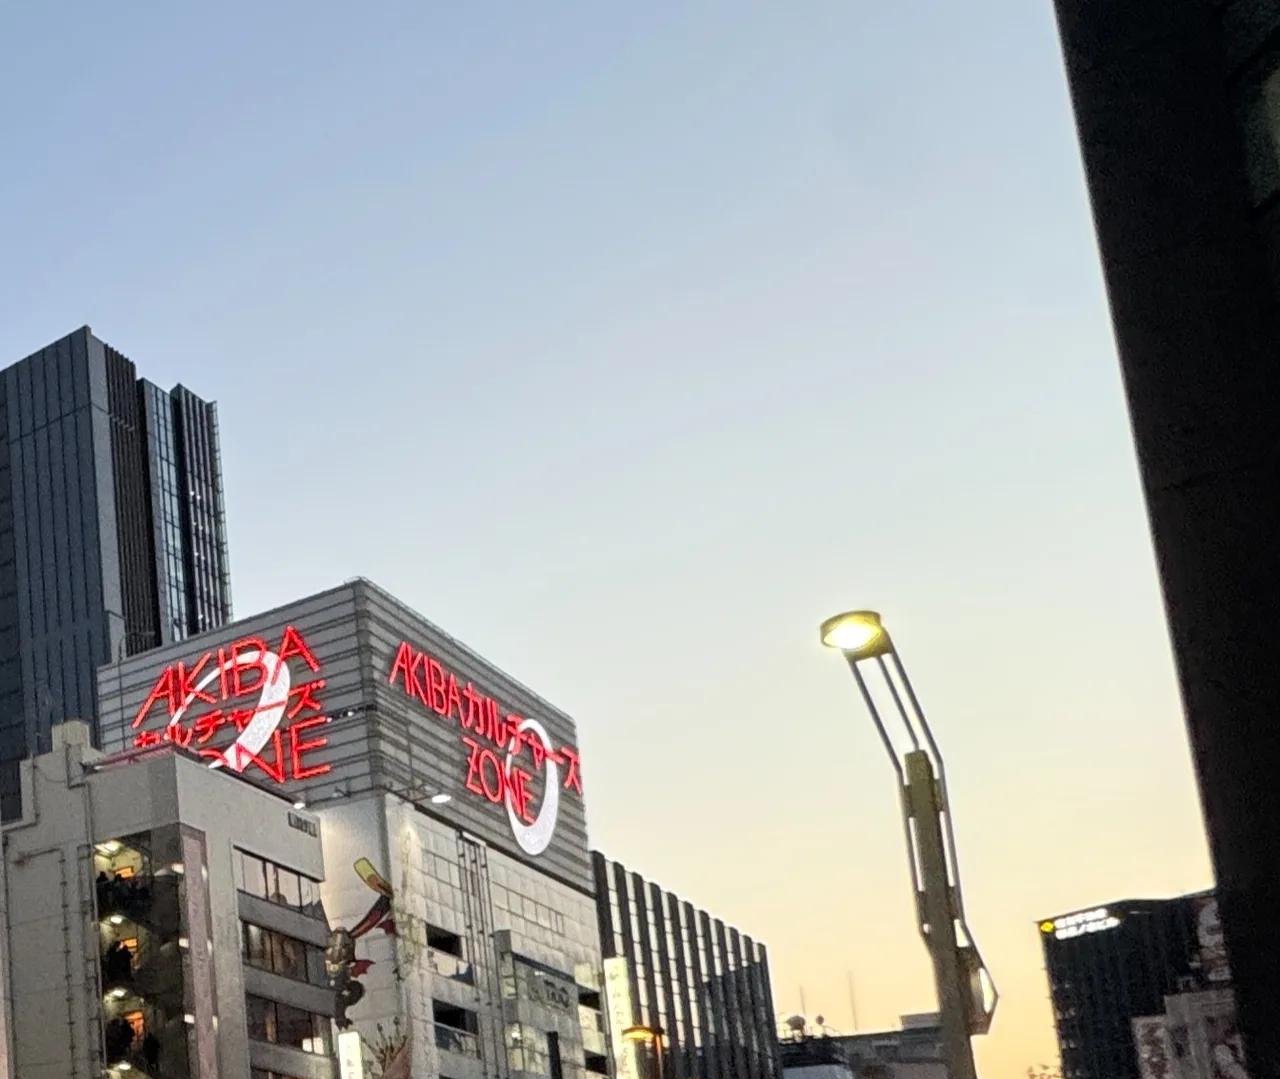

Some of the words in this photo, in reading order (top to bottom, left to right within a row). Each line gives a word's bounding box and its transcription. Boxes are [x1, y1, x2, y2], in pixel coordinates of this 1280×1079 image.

[132, 625, 320, 728] AKIBA
[389, 641, 584, 796] AKIBAカルチャーズ
[463, 736, 536, 826] ZONE
